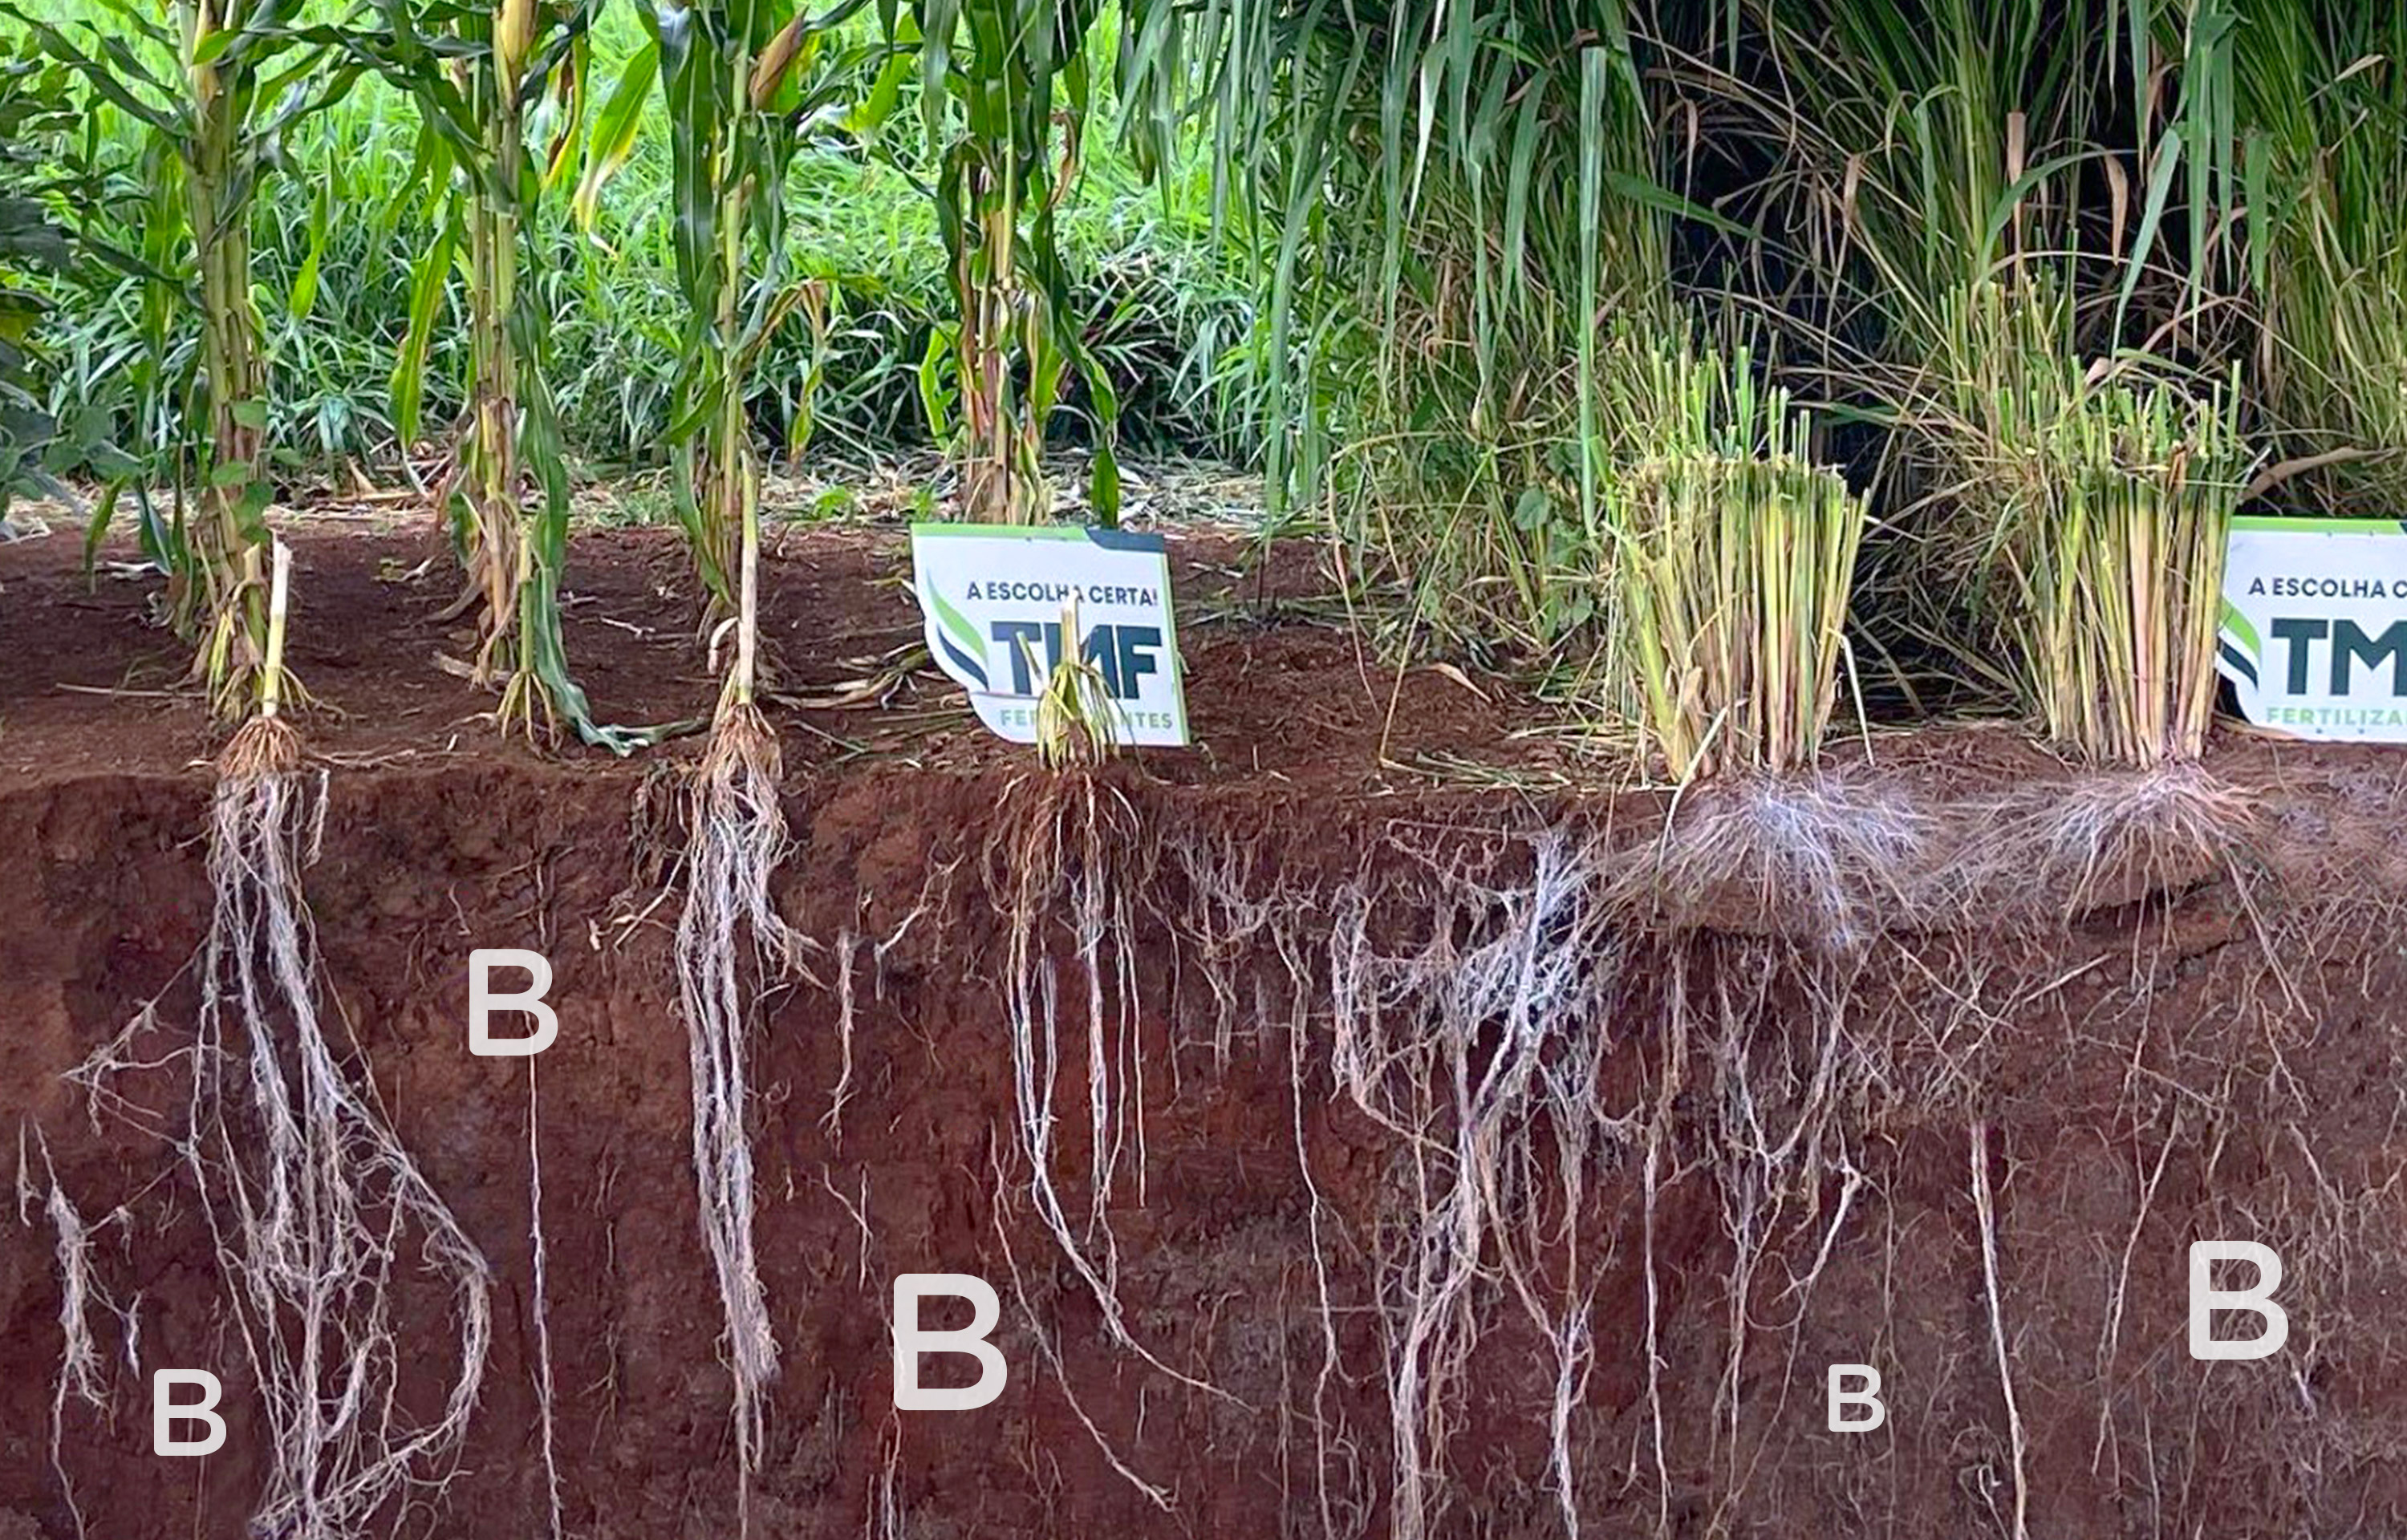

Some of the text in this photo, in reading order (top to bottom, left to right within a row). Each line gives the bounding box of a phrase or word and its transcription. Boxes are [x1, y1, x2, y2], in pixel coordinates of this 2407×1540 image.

[967, 582, 982, 600] A
[1089, 586, 1159, 606] CERTA!
[2248, 578, 2265, 596] A
[2272, 578, 2386, 598] ESCOLHA
[2267, 707, 2407, 726] FERTILIZA
